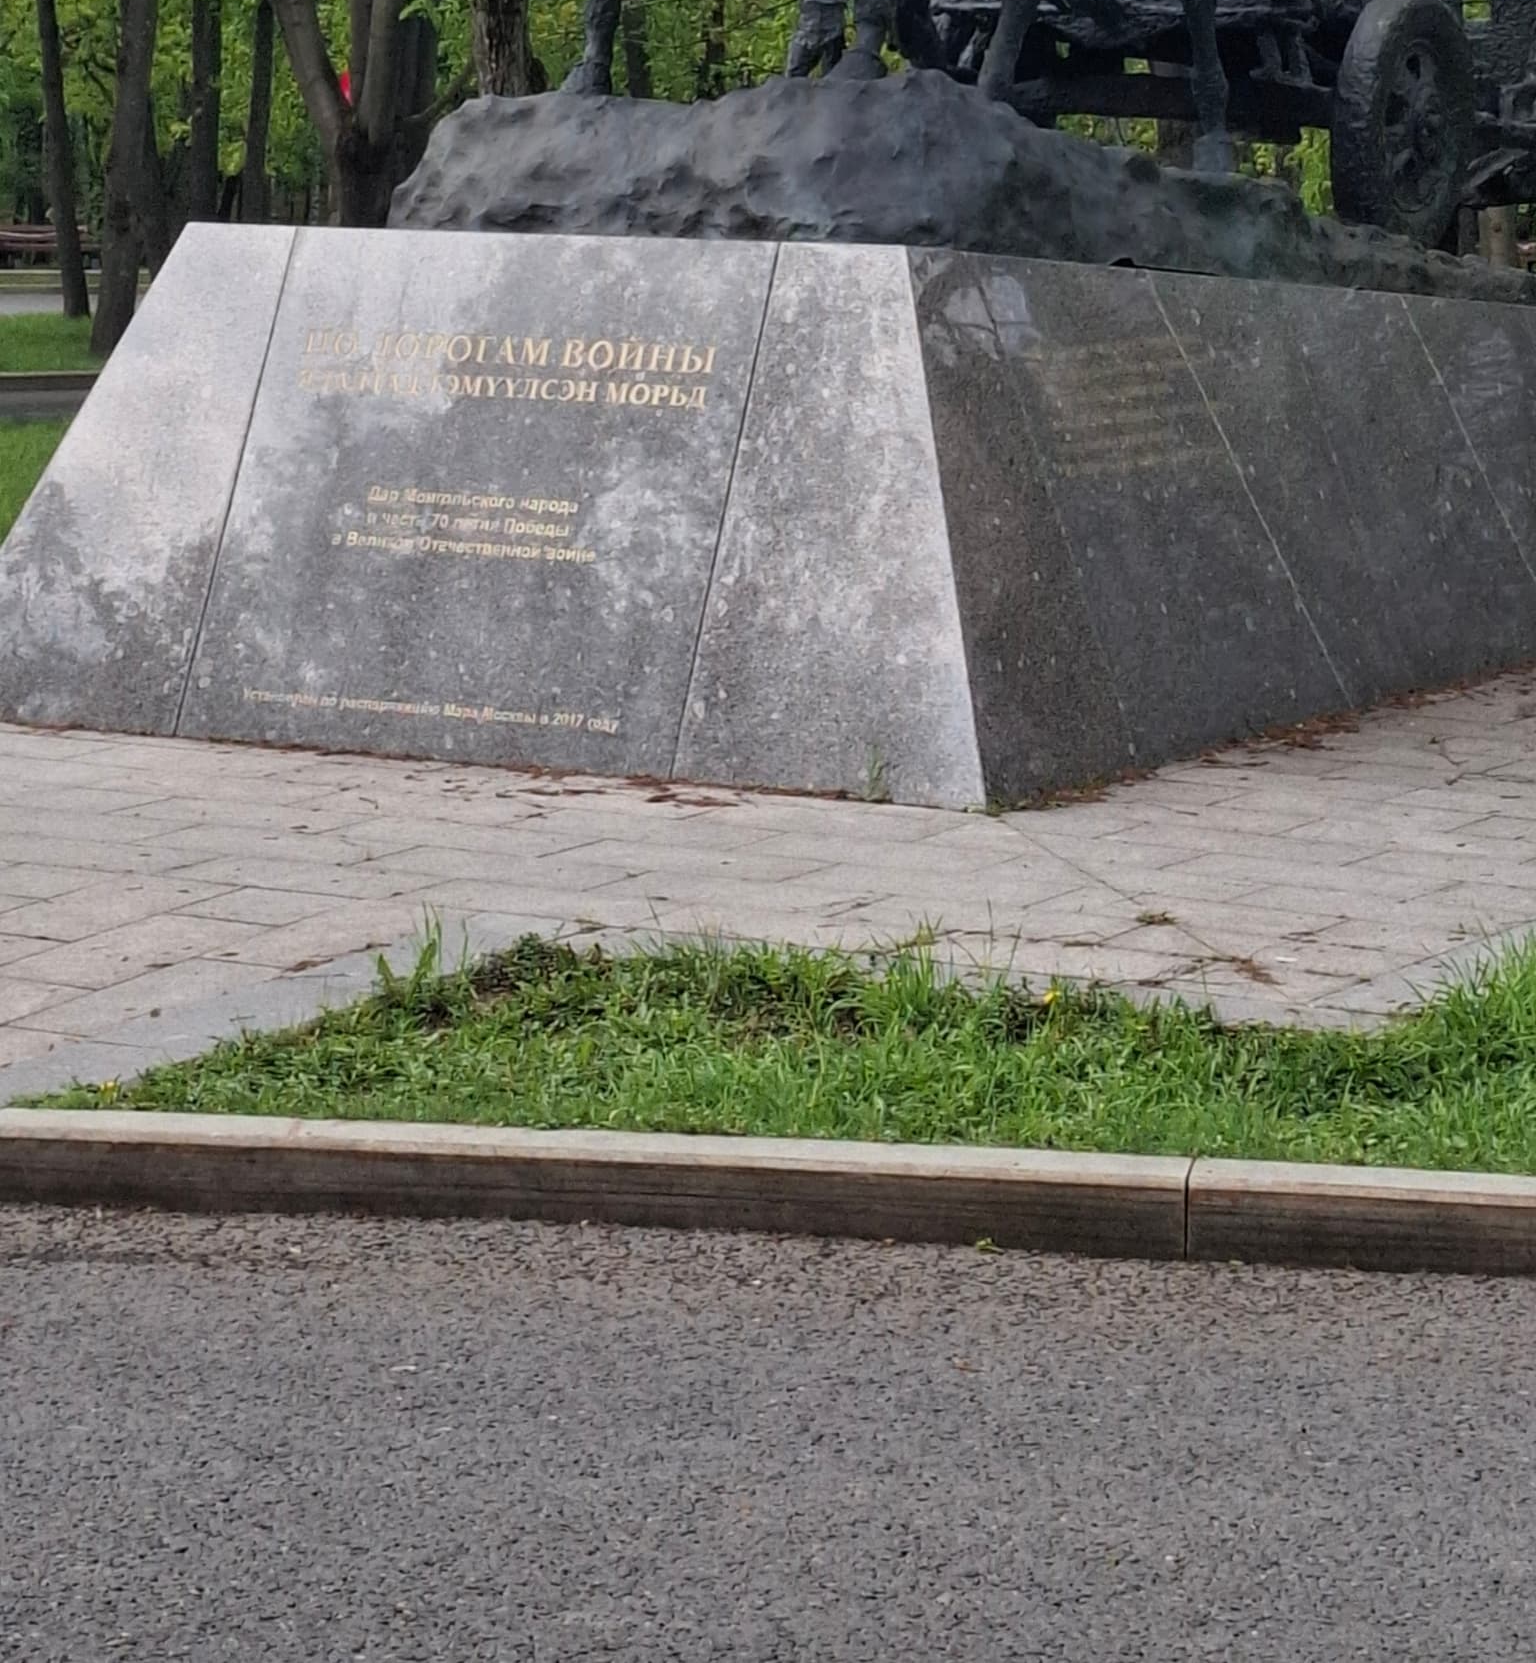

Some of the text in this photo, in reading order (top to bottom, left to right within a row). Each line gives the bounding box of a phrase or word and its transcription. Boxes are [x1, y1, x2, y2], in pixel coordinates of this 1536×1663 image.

[560, 335, 717, 375] ВОЙНЫ
[604, 380, 708, 411] МОРЬД
[368, 485, 399, 505] Дар
[520, 497, 580, 517] народа
[431, 513, 450, 529] 70
[504, 517, 570, 538] Победы
[552, 712, 585, 728] 2017
